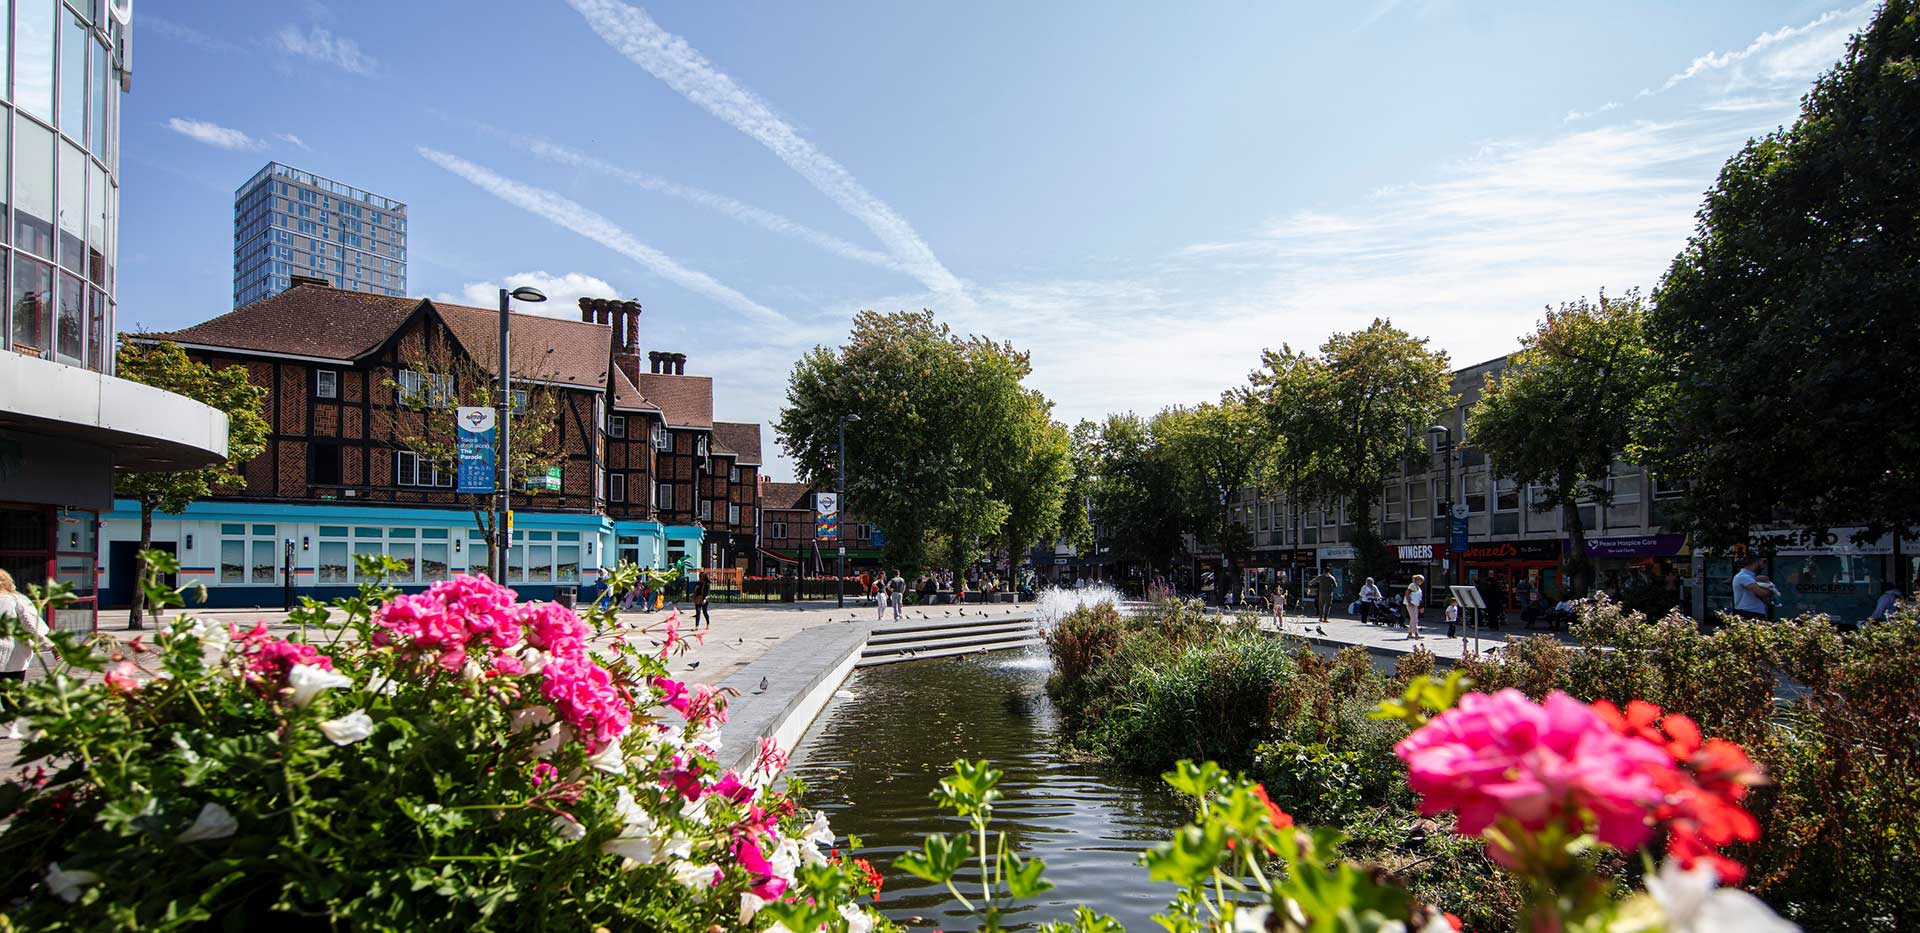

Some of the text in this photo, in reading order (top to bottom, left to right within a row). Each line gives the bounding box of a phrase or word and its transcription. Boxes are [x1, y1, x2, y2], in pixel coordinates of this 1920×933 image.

[1747, 531, 1839, 547] ONCEPO
[1398, 545, 1433, 559] WINGERS
[1796, 583, 1857, 592] CONCEPTO
